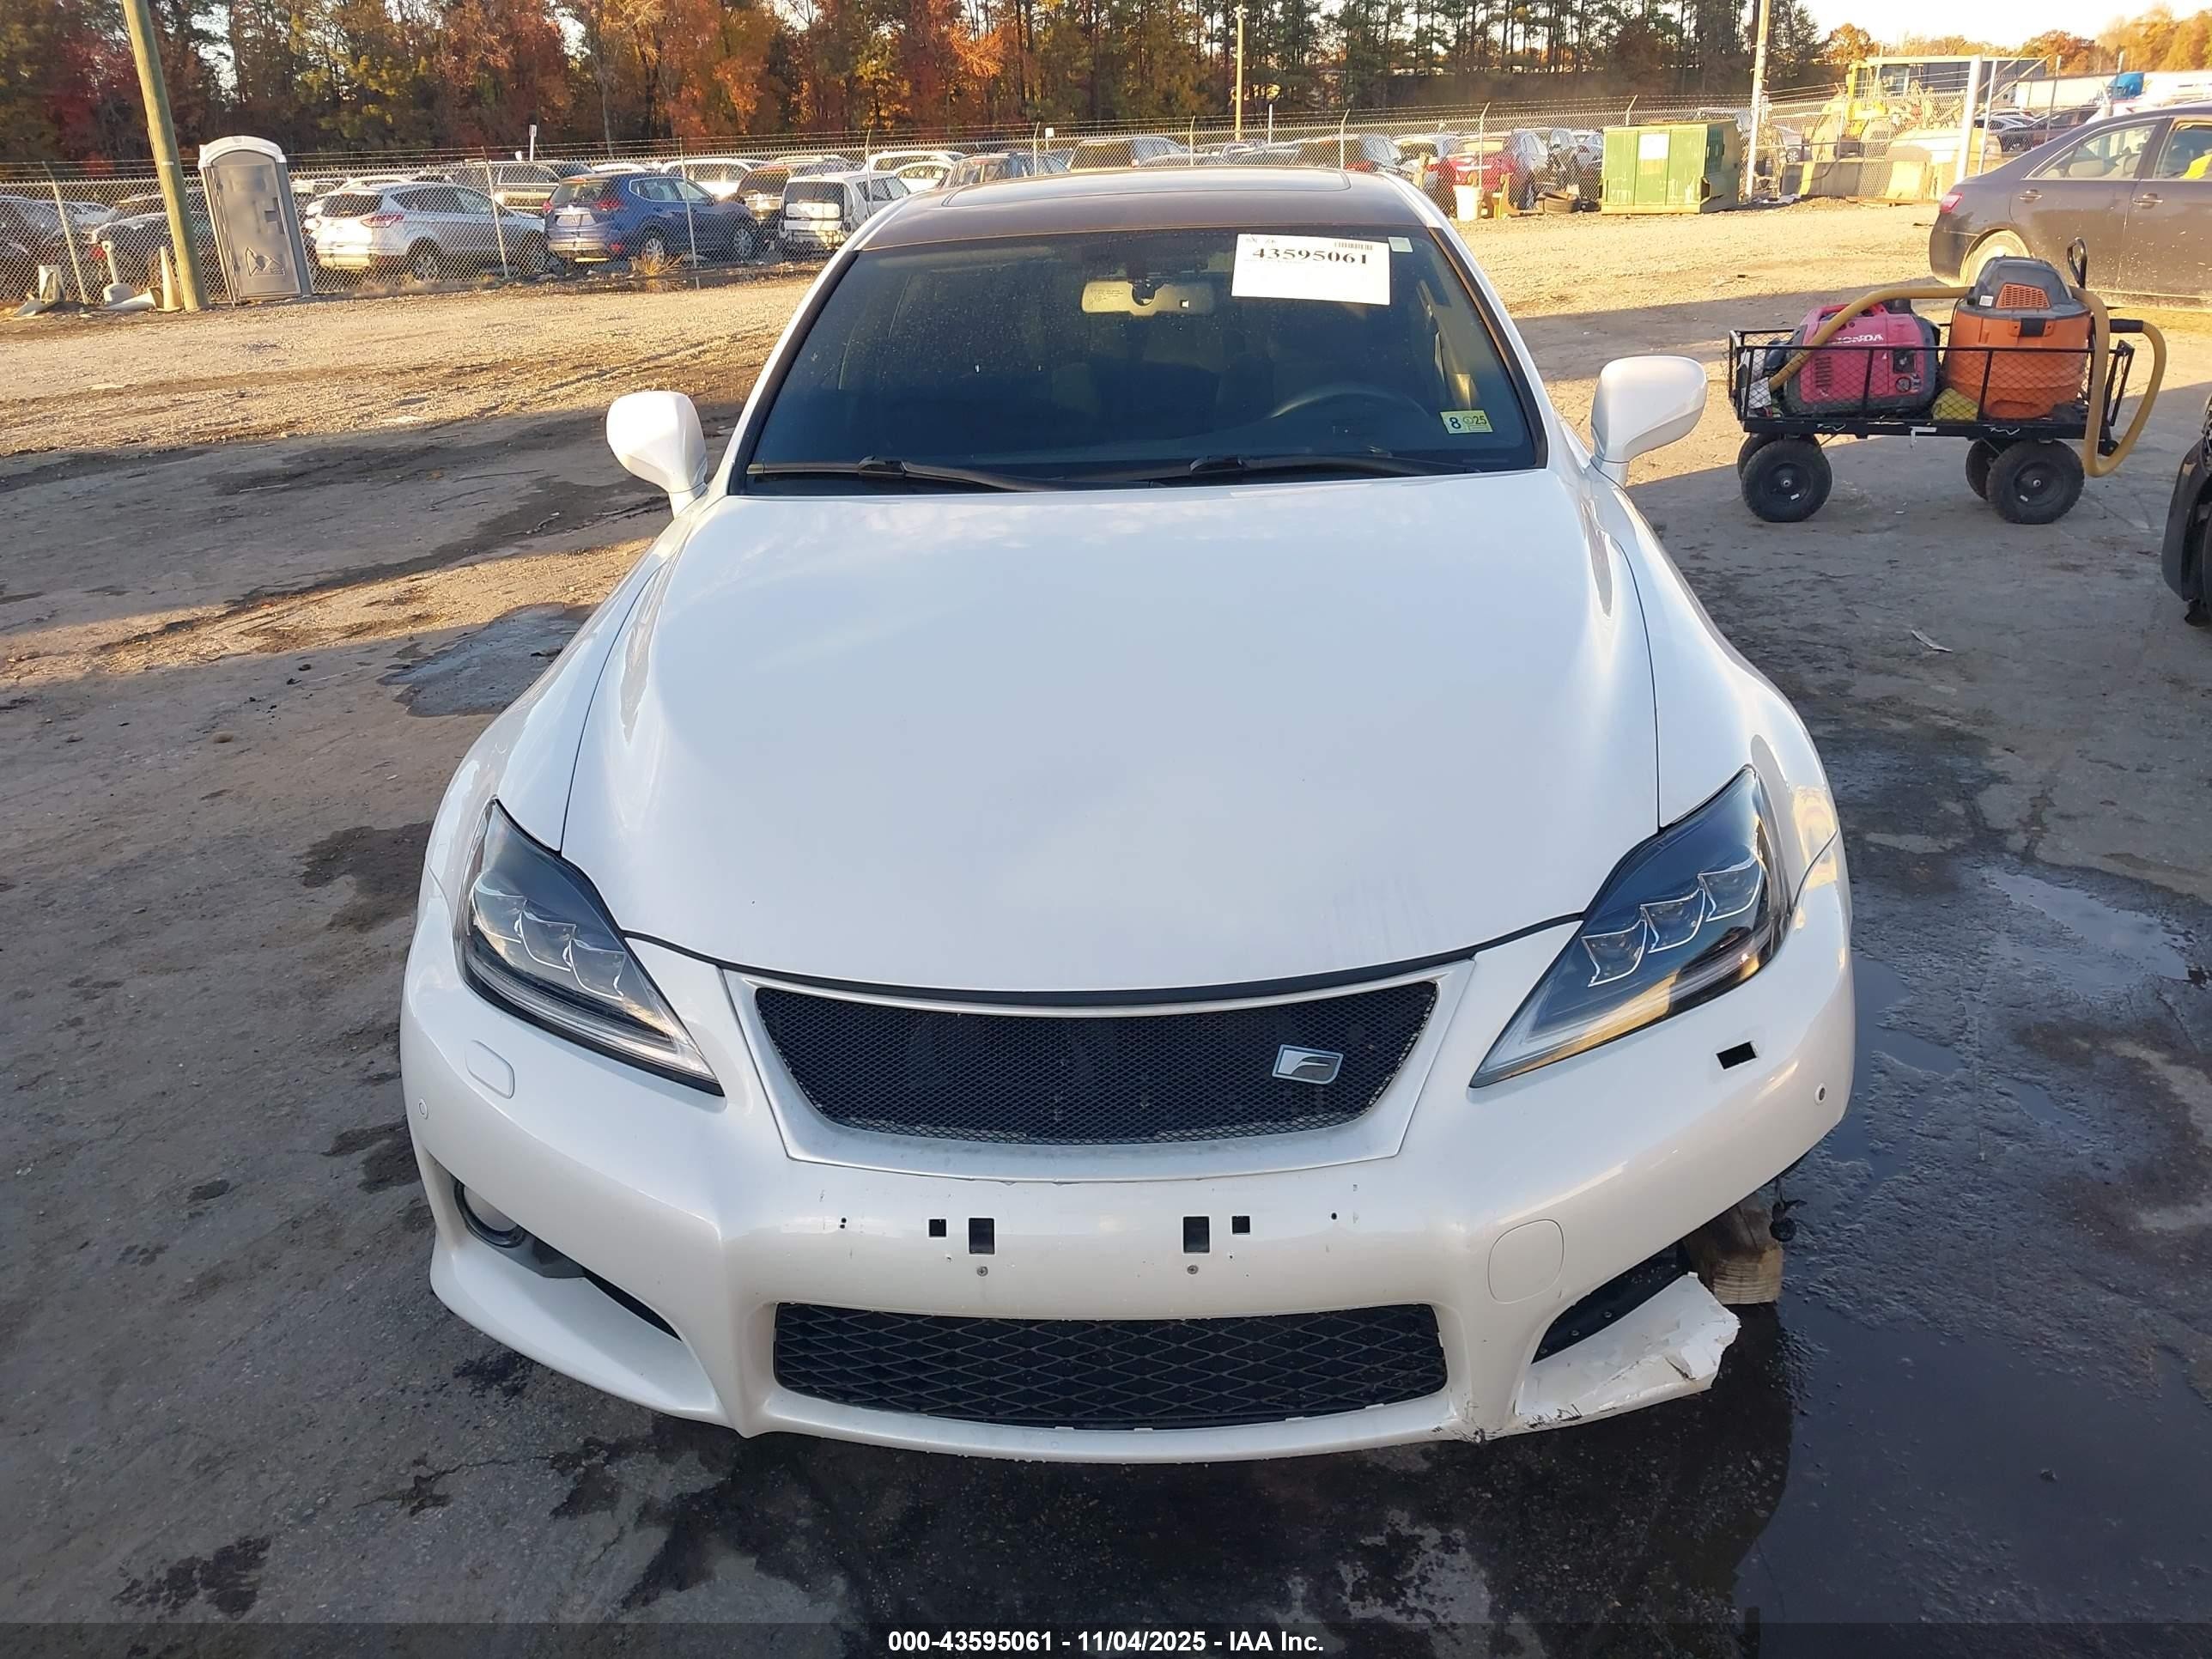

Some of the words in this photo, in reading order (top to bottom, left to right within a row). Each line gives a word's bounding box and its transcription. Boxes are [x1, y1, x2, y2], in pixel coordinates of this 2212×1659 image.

[1252, 248, 1367, 264] 43595061
[1449, 416, 1462, 429] 8
[1473, 415, 1487, 425] 25
